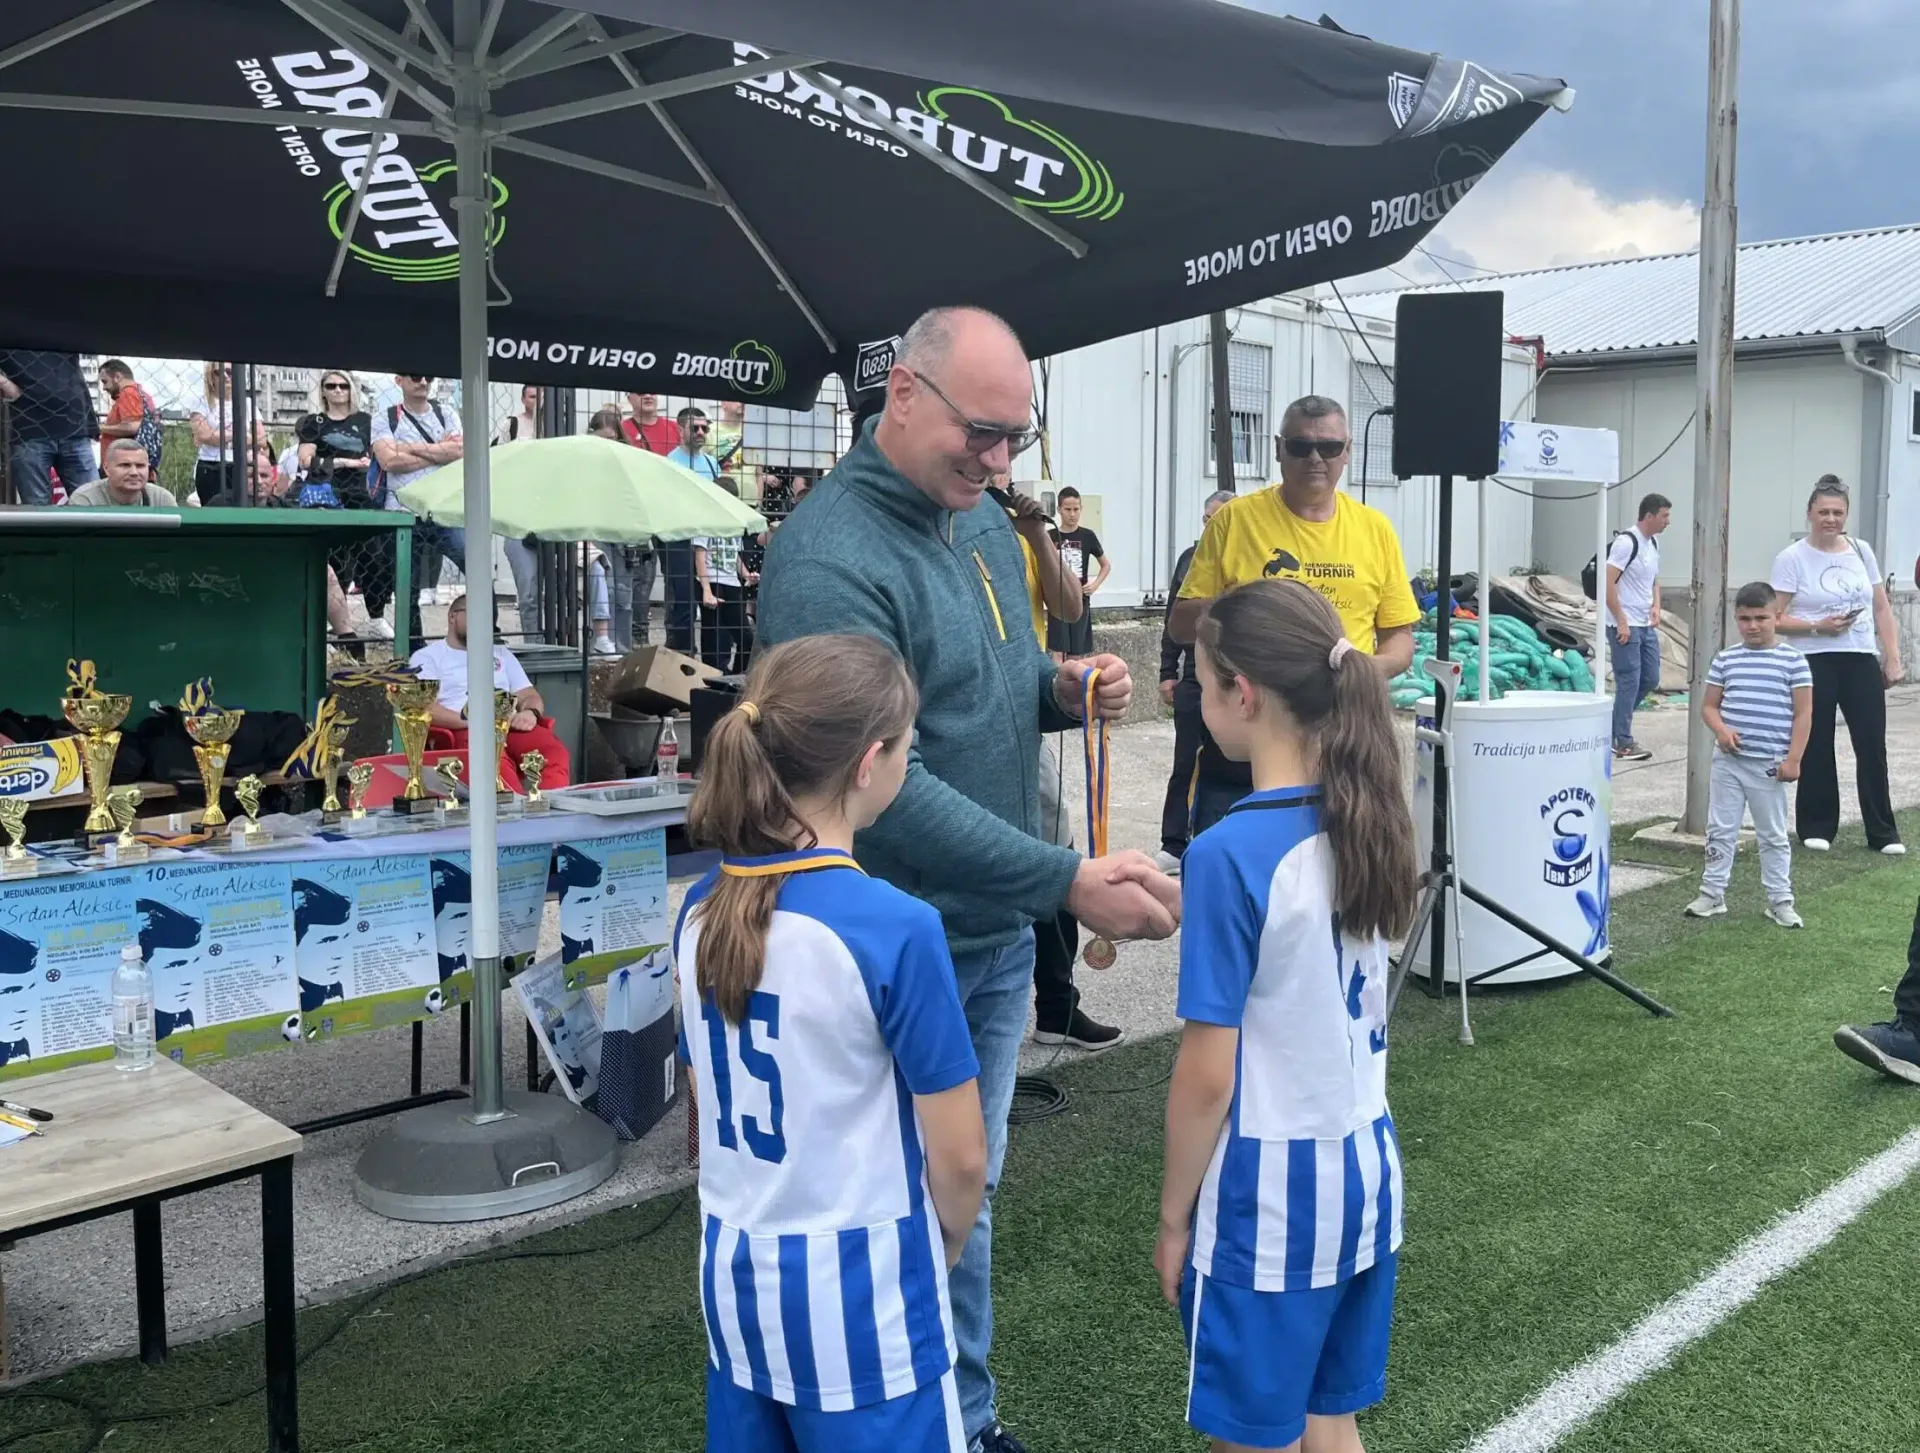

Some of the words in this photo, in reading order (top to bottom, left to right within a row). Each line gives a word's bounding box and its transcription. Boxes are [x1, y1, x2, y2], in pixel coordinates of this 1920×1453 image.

[1305, 567, 1355, 578] TURNIR
[1473, 742, 1536, 759] Tradicija
[1538, 744, 1546, 755] u
[1549, 736, 1589, 753] medicini
[1540, 787, 1596, 820] APOTEKE
[59, 880, 106, 893] MEMORIJALNI
[107, 876, 131, 887] TURNIR
[701, 985, 787, 1165] 15
